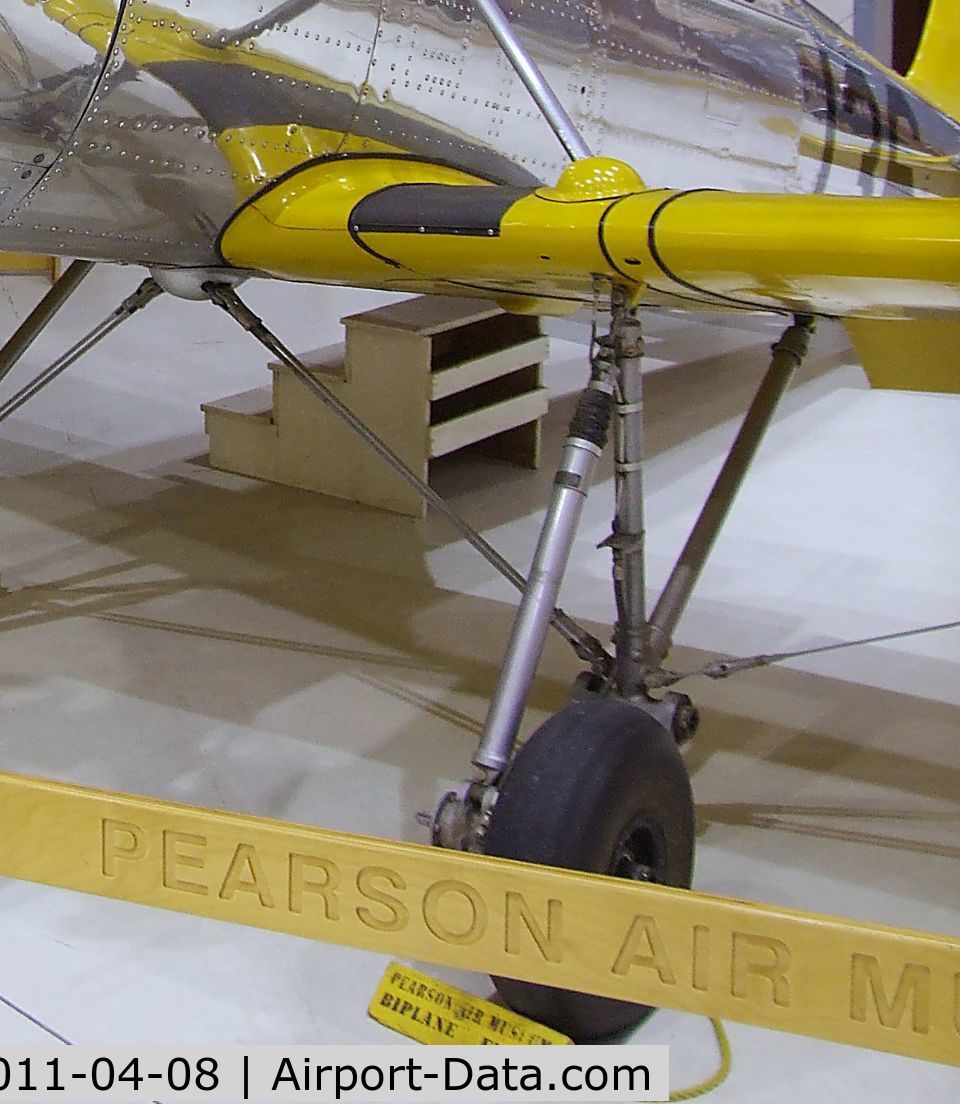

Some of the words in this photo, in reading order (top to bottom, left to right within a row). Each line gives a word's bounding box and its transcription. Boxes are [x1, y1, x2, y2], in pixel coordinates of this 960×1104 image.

[101, 816, 565, 964] PEARSON
[611, 913, 794, 1009] AIR
[389, 970, 453, 1010] PEARSON
[379, 992, 459, 1038] BIPLANE
